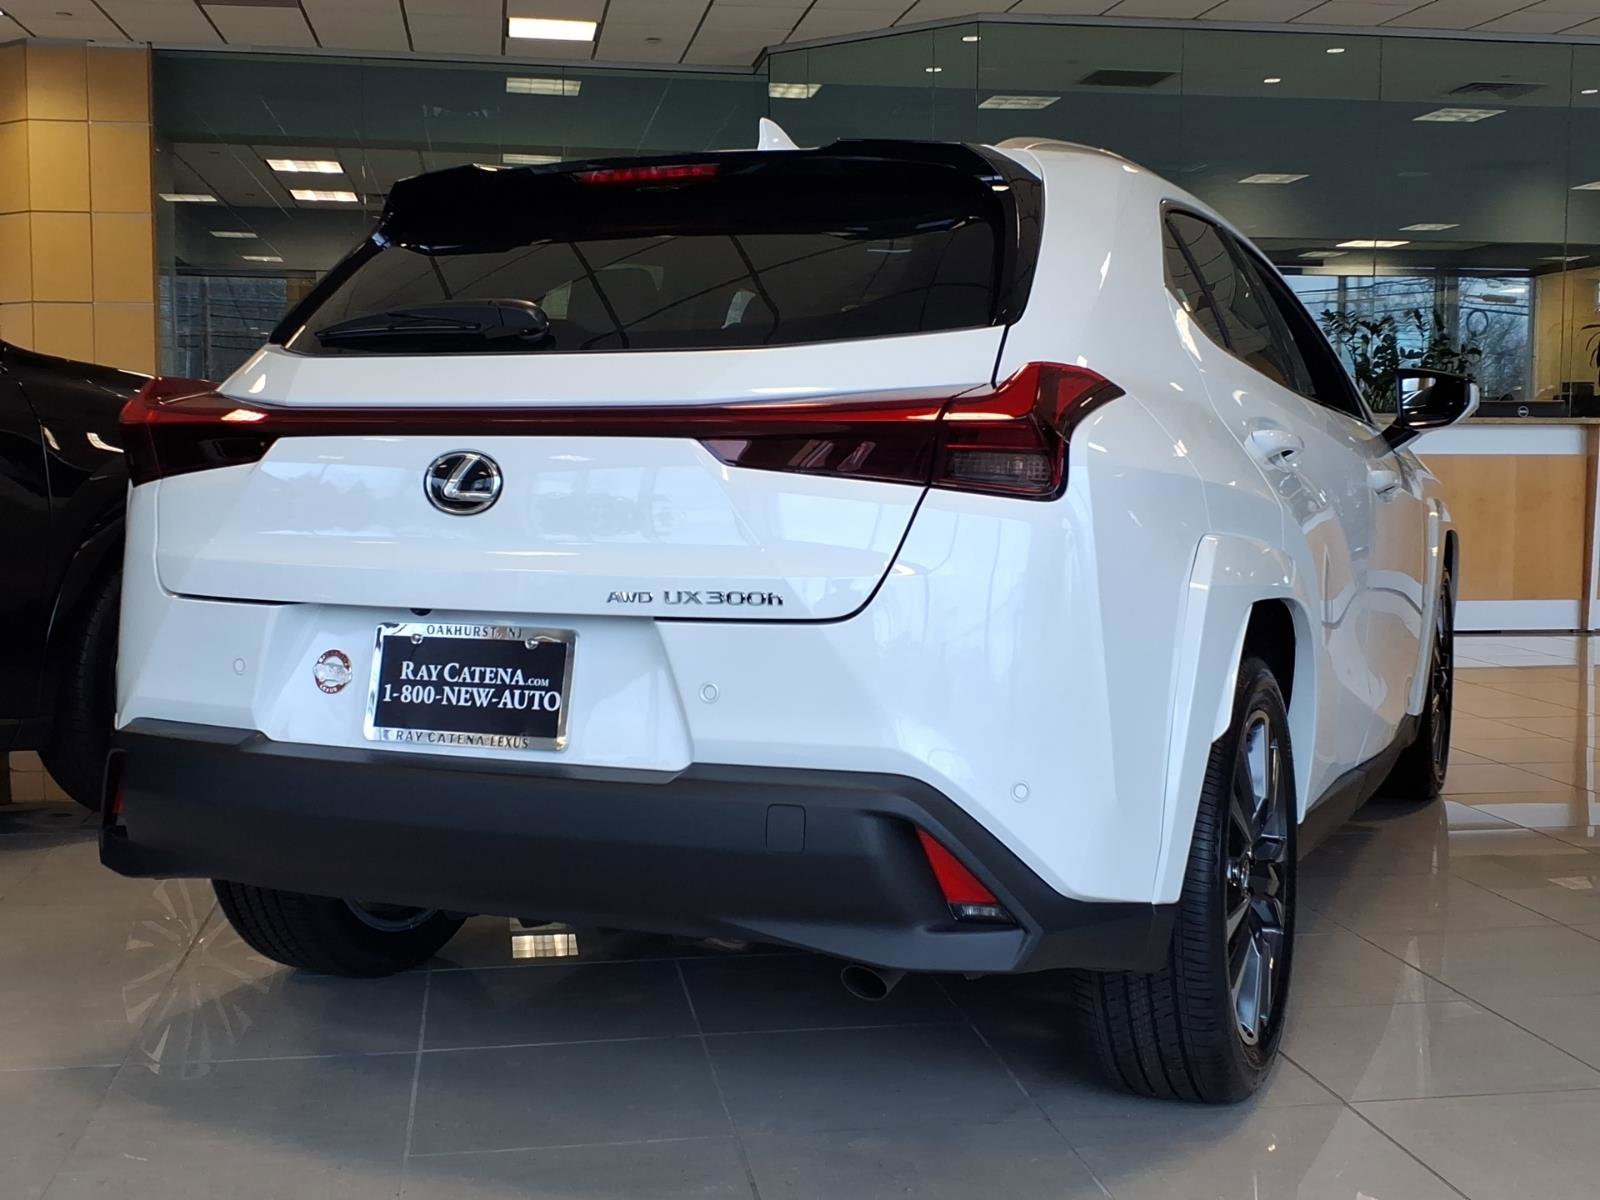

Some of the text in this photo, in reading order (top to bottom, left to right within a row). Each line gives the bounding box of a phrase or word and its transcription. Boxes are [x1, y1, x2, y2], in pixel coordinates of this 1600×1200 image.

[606, 591, 653, 604] AWD
[508, 626, 522, 638] NJ
[382, 684, 561, 711] 1-800-NEW-AUTO
[395, 730, 529, 749] RAY CATENA LEXUS
